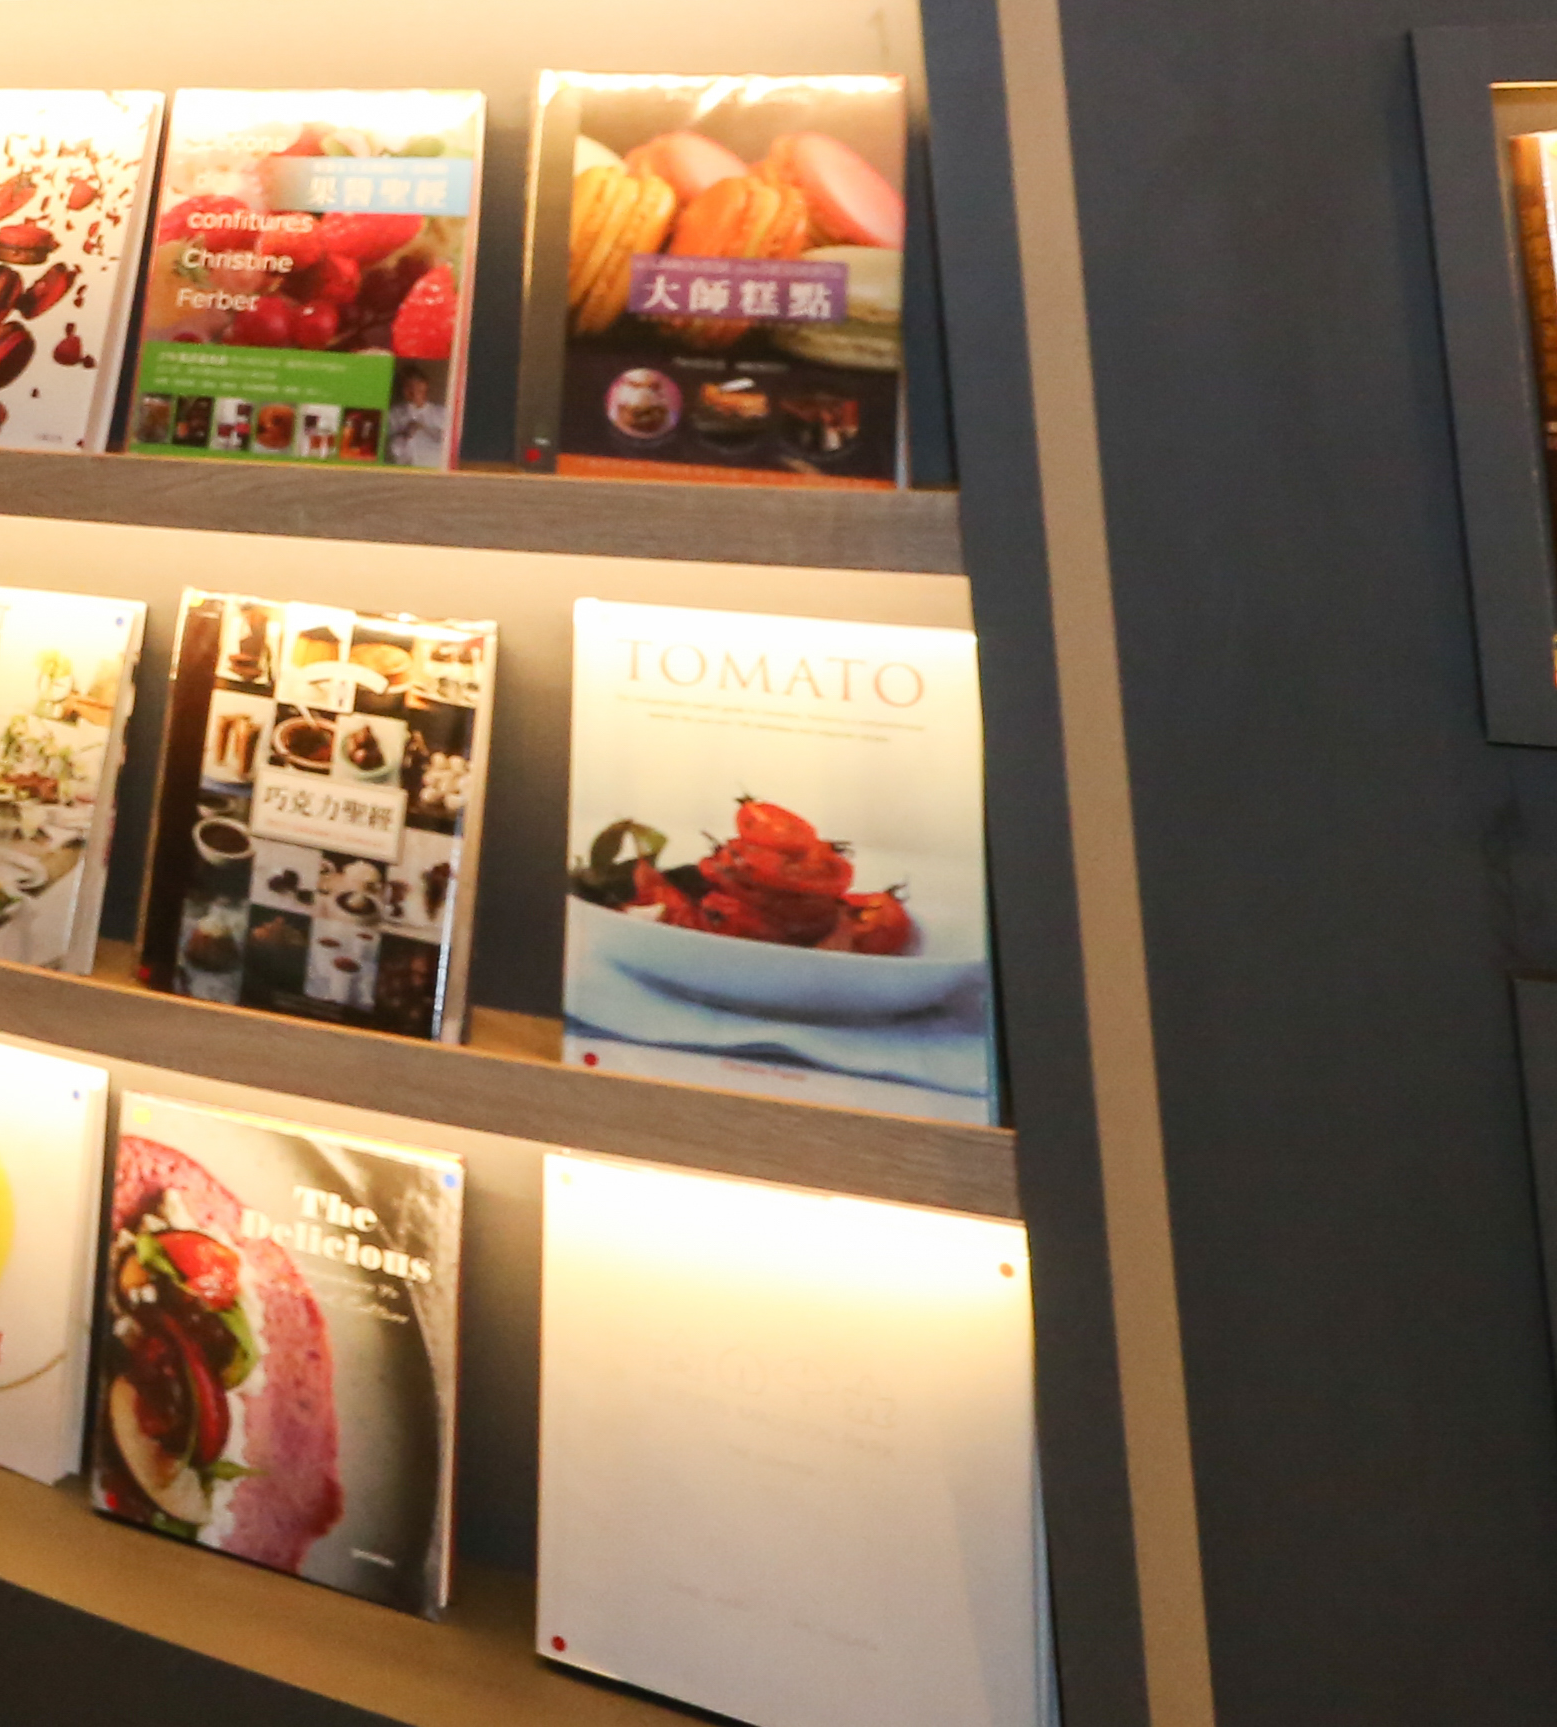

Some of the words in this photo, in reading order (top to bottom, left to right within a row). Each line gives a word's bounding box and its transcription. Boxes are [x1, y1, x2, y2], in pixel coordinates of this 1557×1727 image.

[188, 209, 313, 234] confitures
[182, 249, 294, 273] Christine
[176, 289, 260, 312] Ferber
[643, 275, 832, 319] 大師糕點
[617, 639, 924, 708] TOMATO
[292, 1185, 379, 1233] The
[240, 1208, 432, 1284] Delicious
